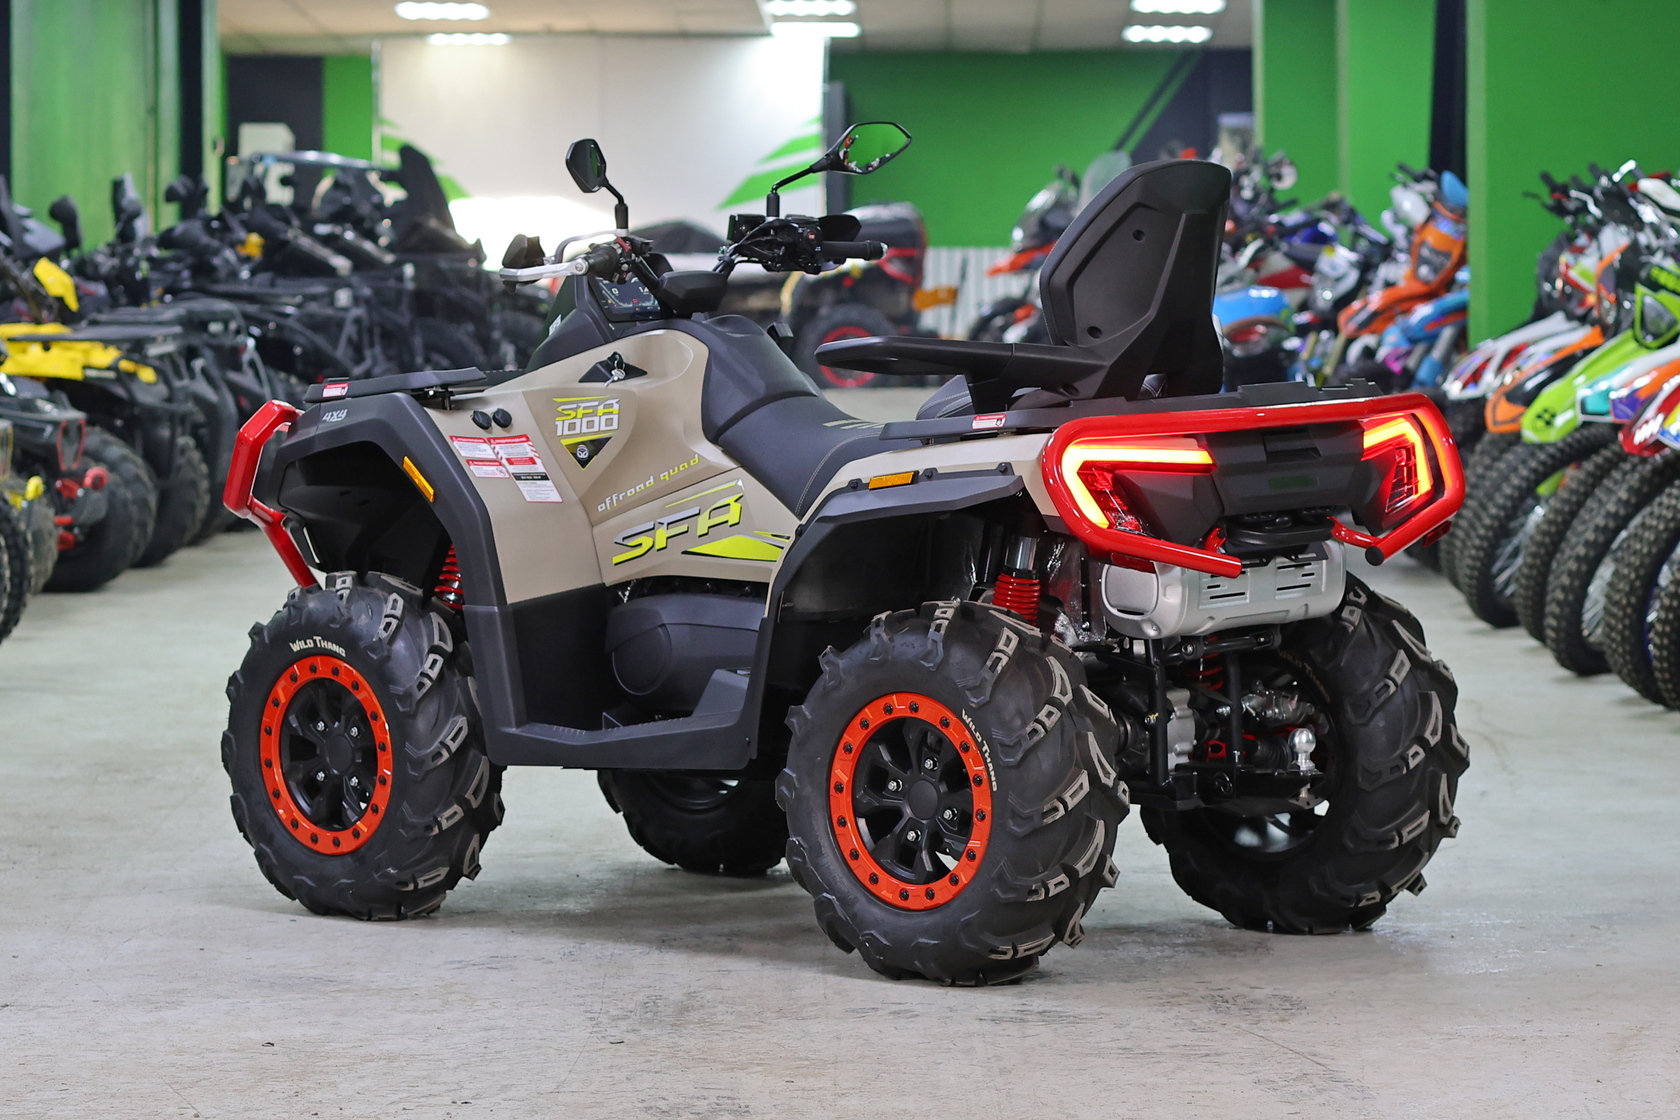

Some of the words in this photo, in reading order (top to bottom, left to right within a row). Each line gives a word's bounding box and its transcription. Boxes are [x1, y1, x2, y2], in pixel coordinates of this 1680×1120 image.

[555, 398, 621, 421] SFA
[555, 414, 619, 437] 1000
[597, 476, 655, 513] offroad
[660, 454, 700, 481] quad
[612, 492, 744, 566] SFA
